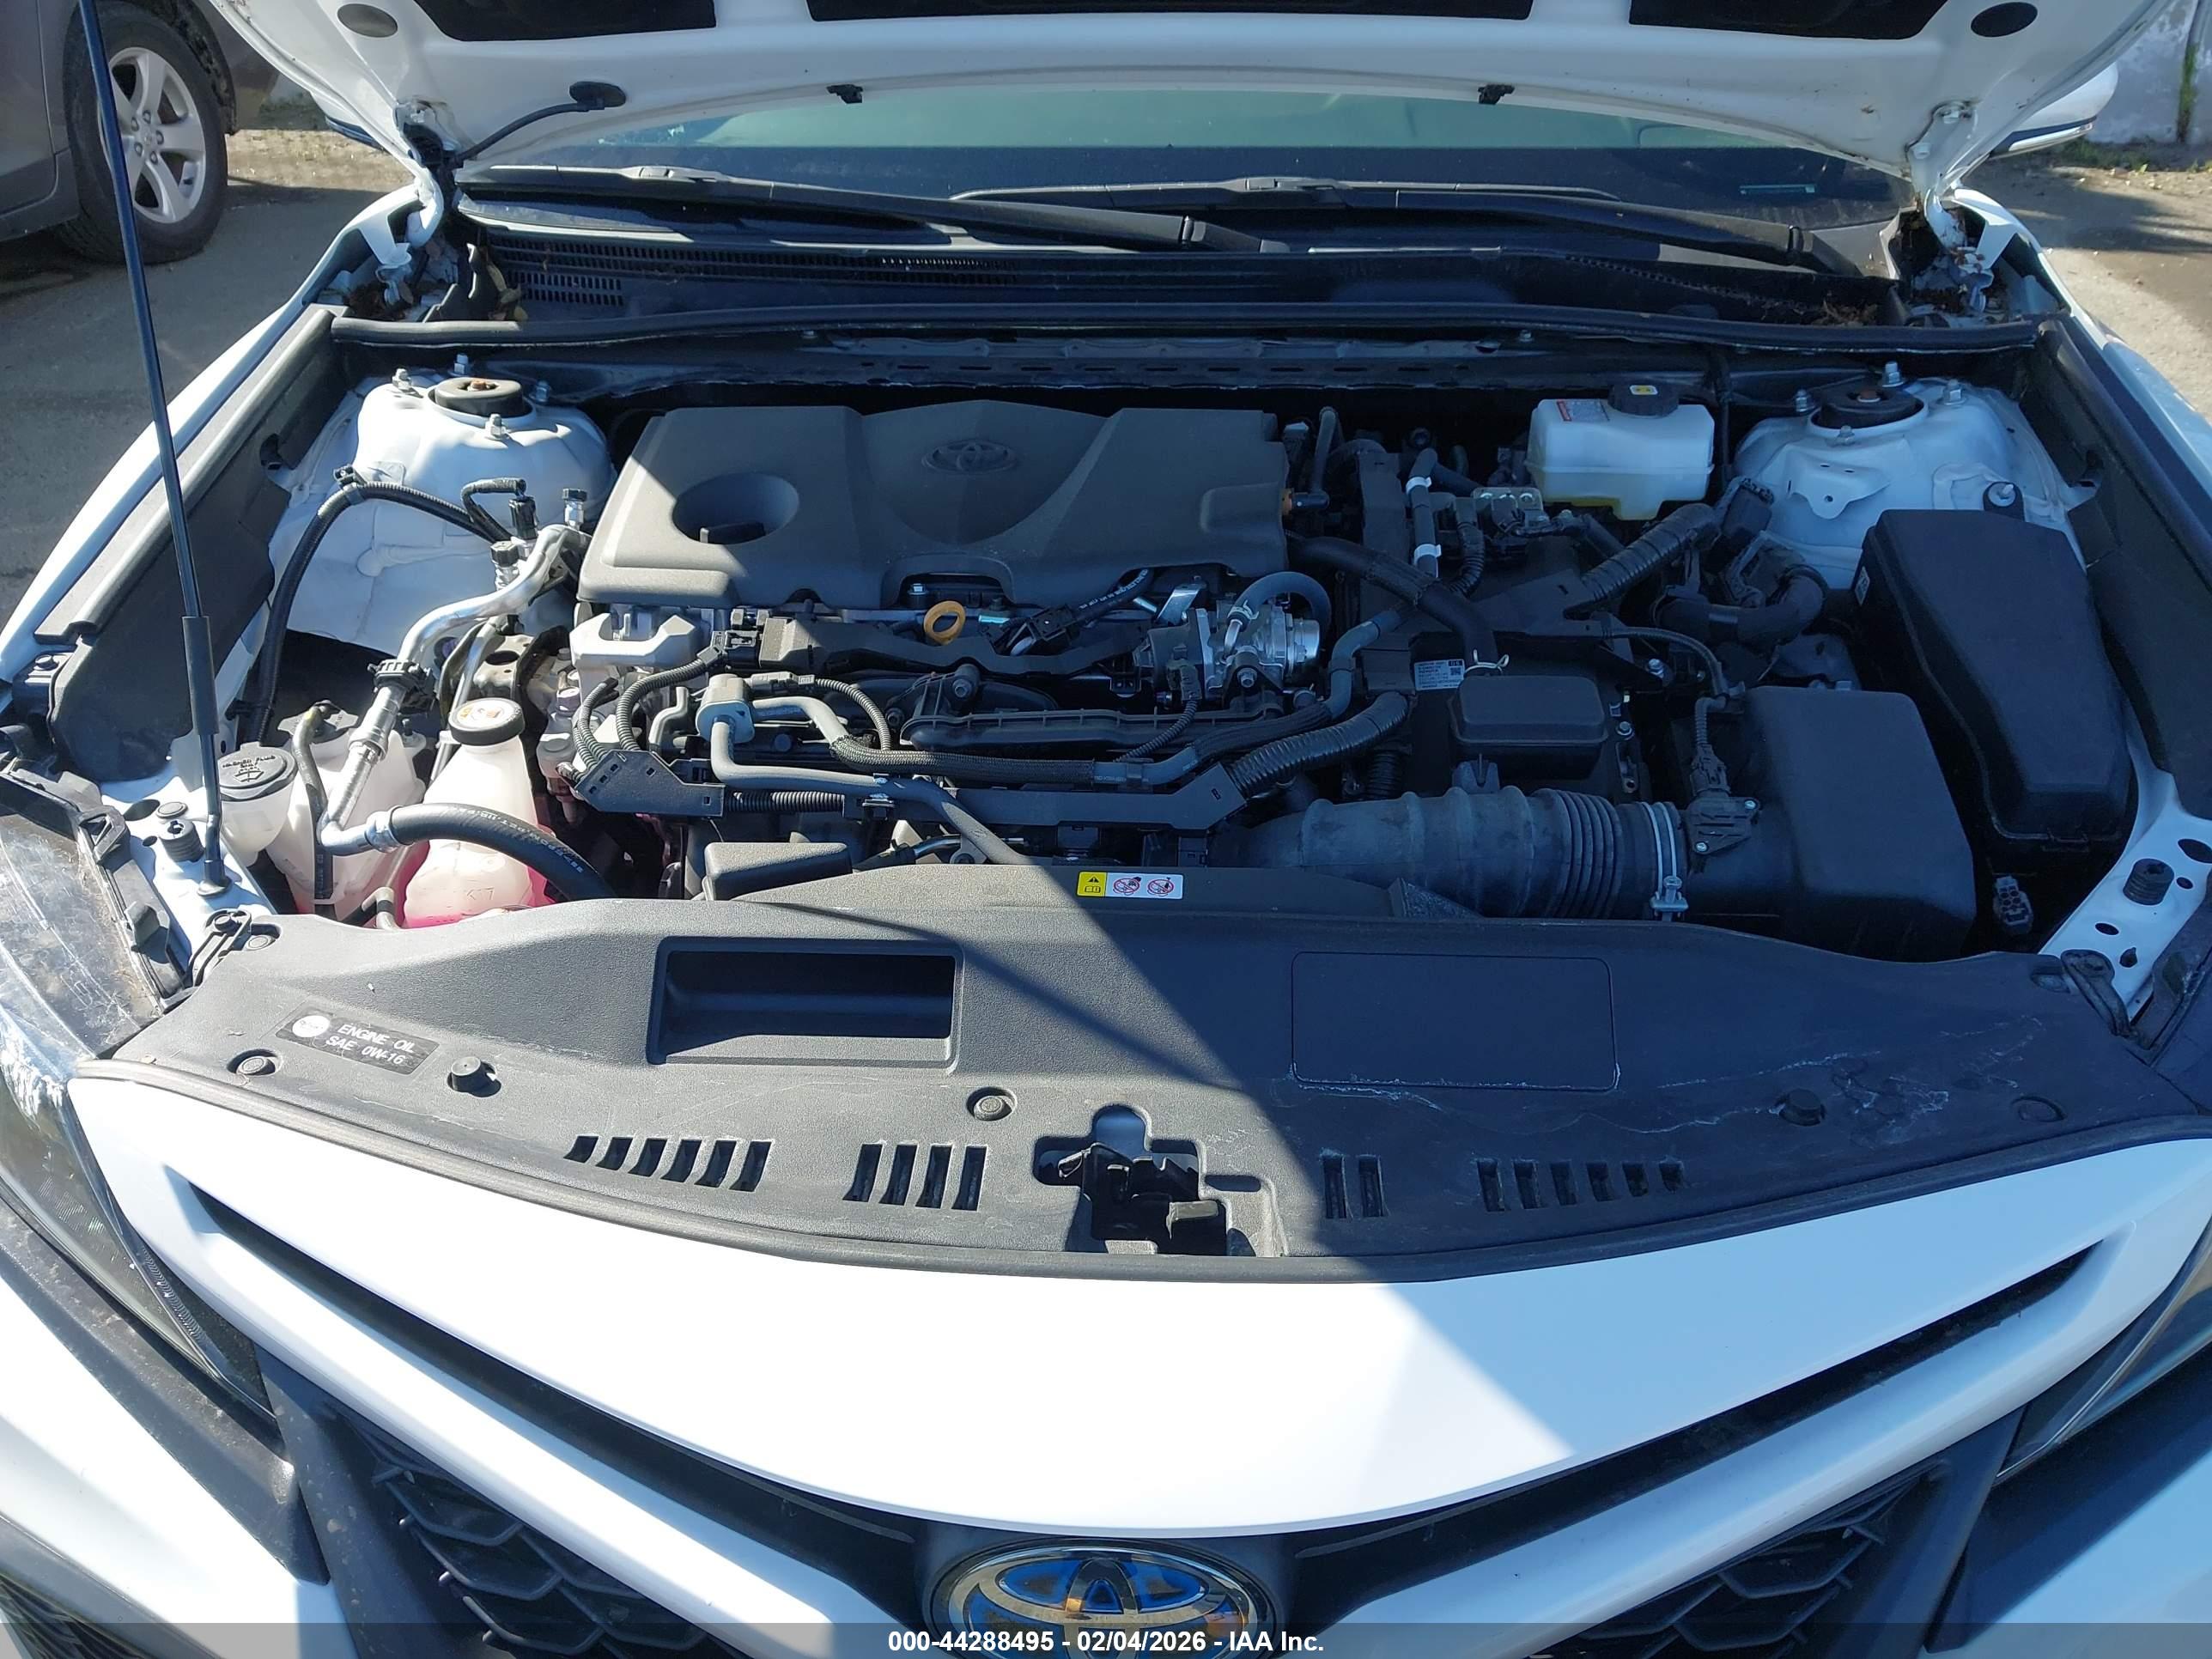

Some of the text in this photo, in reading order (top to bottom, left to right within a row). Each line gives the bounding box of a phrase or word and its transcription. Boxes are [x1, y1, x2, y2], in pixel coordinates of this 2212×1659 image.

[326, 1036, 406, 1064] SAE 0W-16
[337, 1023, 390, 1045] ENGINE
[393, 1040, 415, 1054] OIL
